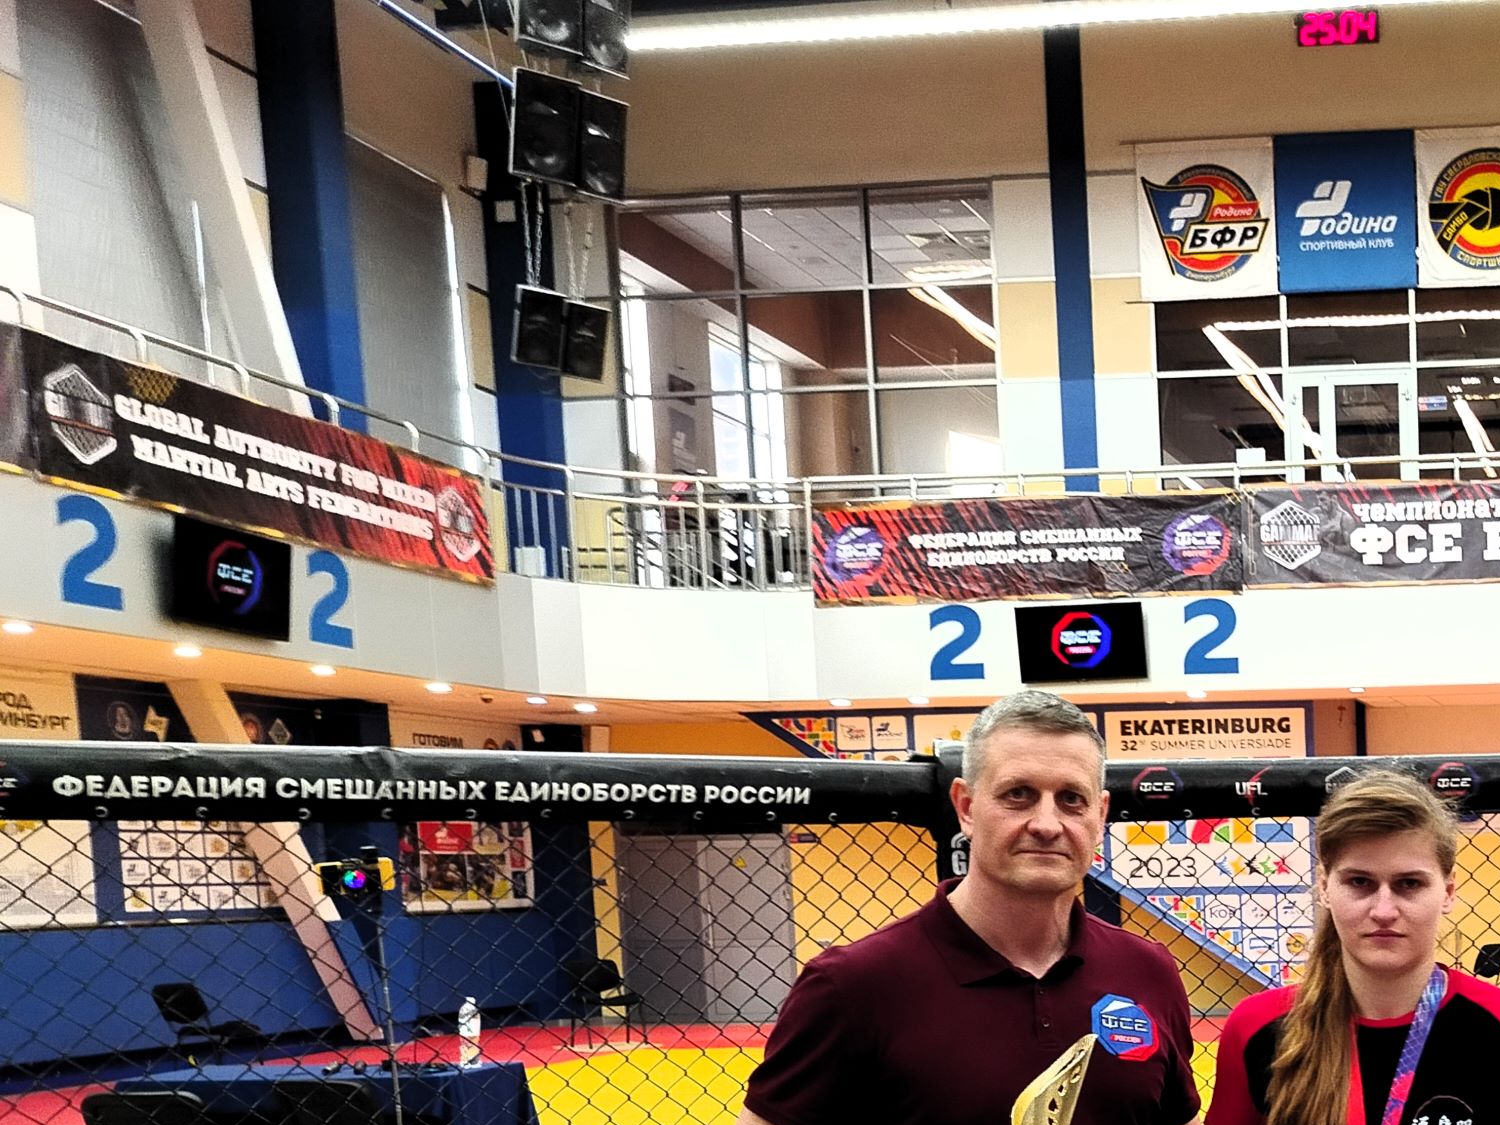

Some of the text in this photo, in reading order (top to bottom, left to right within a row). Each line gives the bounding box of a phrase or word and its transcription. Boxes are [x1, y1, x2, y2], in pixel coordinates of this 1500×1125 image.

[1300, 9, 1377, 46] 25.04
[1188, 226, 1259, 249] БФР
[1300, 237, 1395, 252] СПОРТИВНЫЙ КЛУБ
[113, 393, 211, 445] GLOBAL
[213, 424, 337, 482] AUTHORITY
[340, 462, 381, 496] FOR
[130, 434, 244, 489] MARTIAL
[246, 467, 305, 505] ARTS
[306, 484, 434, 541] FEDERATIONS
[908, 527, 1143, 550] ФЕДЕРАЦИЯ СМЕШАННЫХ
[1349, 521, 1463, 566] ФСЕ
[57, 494, 125, 610] 2
[927, 547, 1125, 569] ЕДИНОБОРСТВ РОССИИ
[307, 550, 354, 648] 2
[929, 605, 985, 680] 2
[1184, 599, 1240, 674] 2
[1120, 716, 1291, 737] EKATERINBURG
[1152, 740, 1206, 752] SUMMER
[1209, 738, 1292, 750] UNIVERSIADE
[52, 774, 811, 805] ФЕДЕРАЦИЯ СМЕШАННЫХ ЕДИНОБОРСТВ РОССИИ
[1139, 781, 1176, 792] ФСЕ
[1235, 781, 1268, 795] UFL
[1437, 777, 1472, 789] ФСЕ
[1129, 856, 1197, 878] 2023
[1101, 1013, 1148, 1033] ФСЕ
